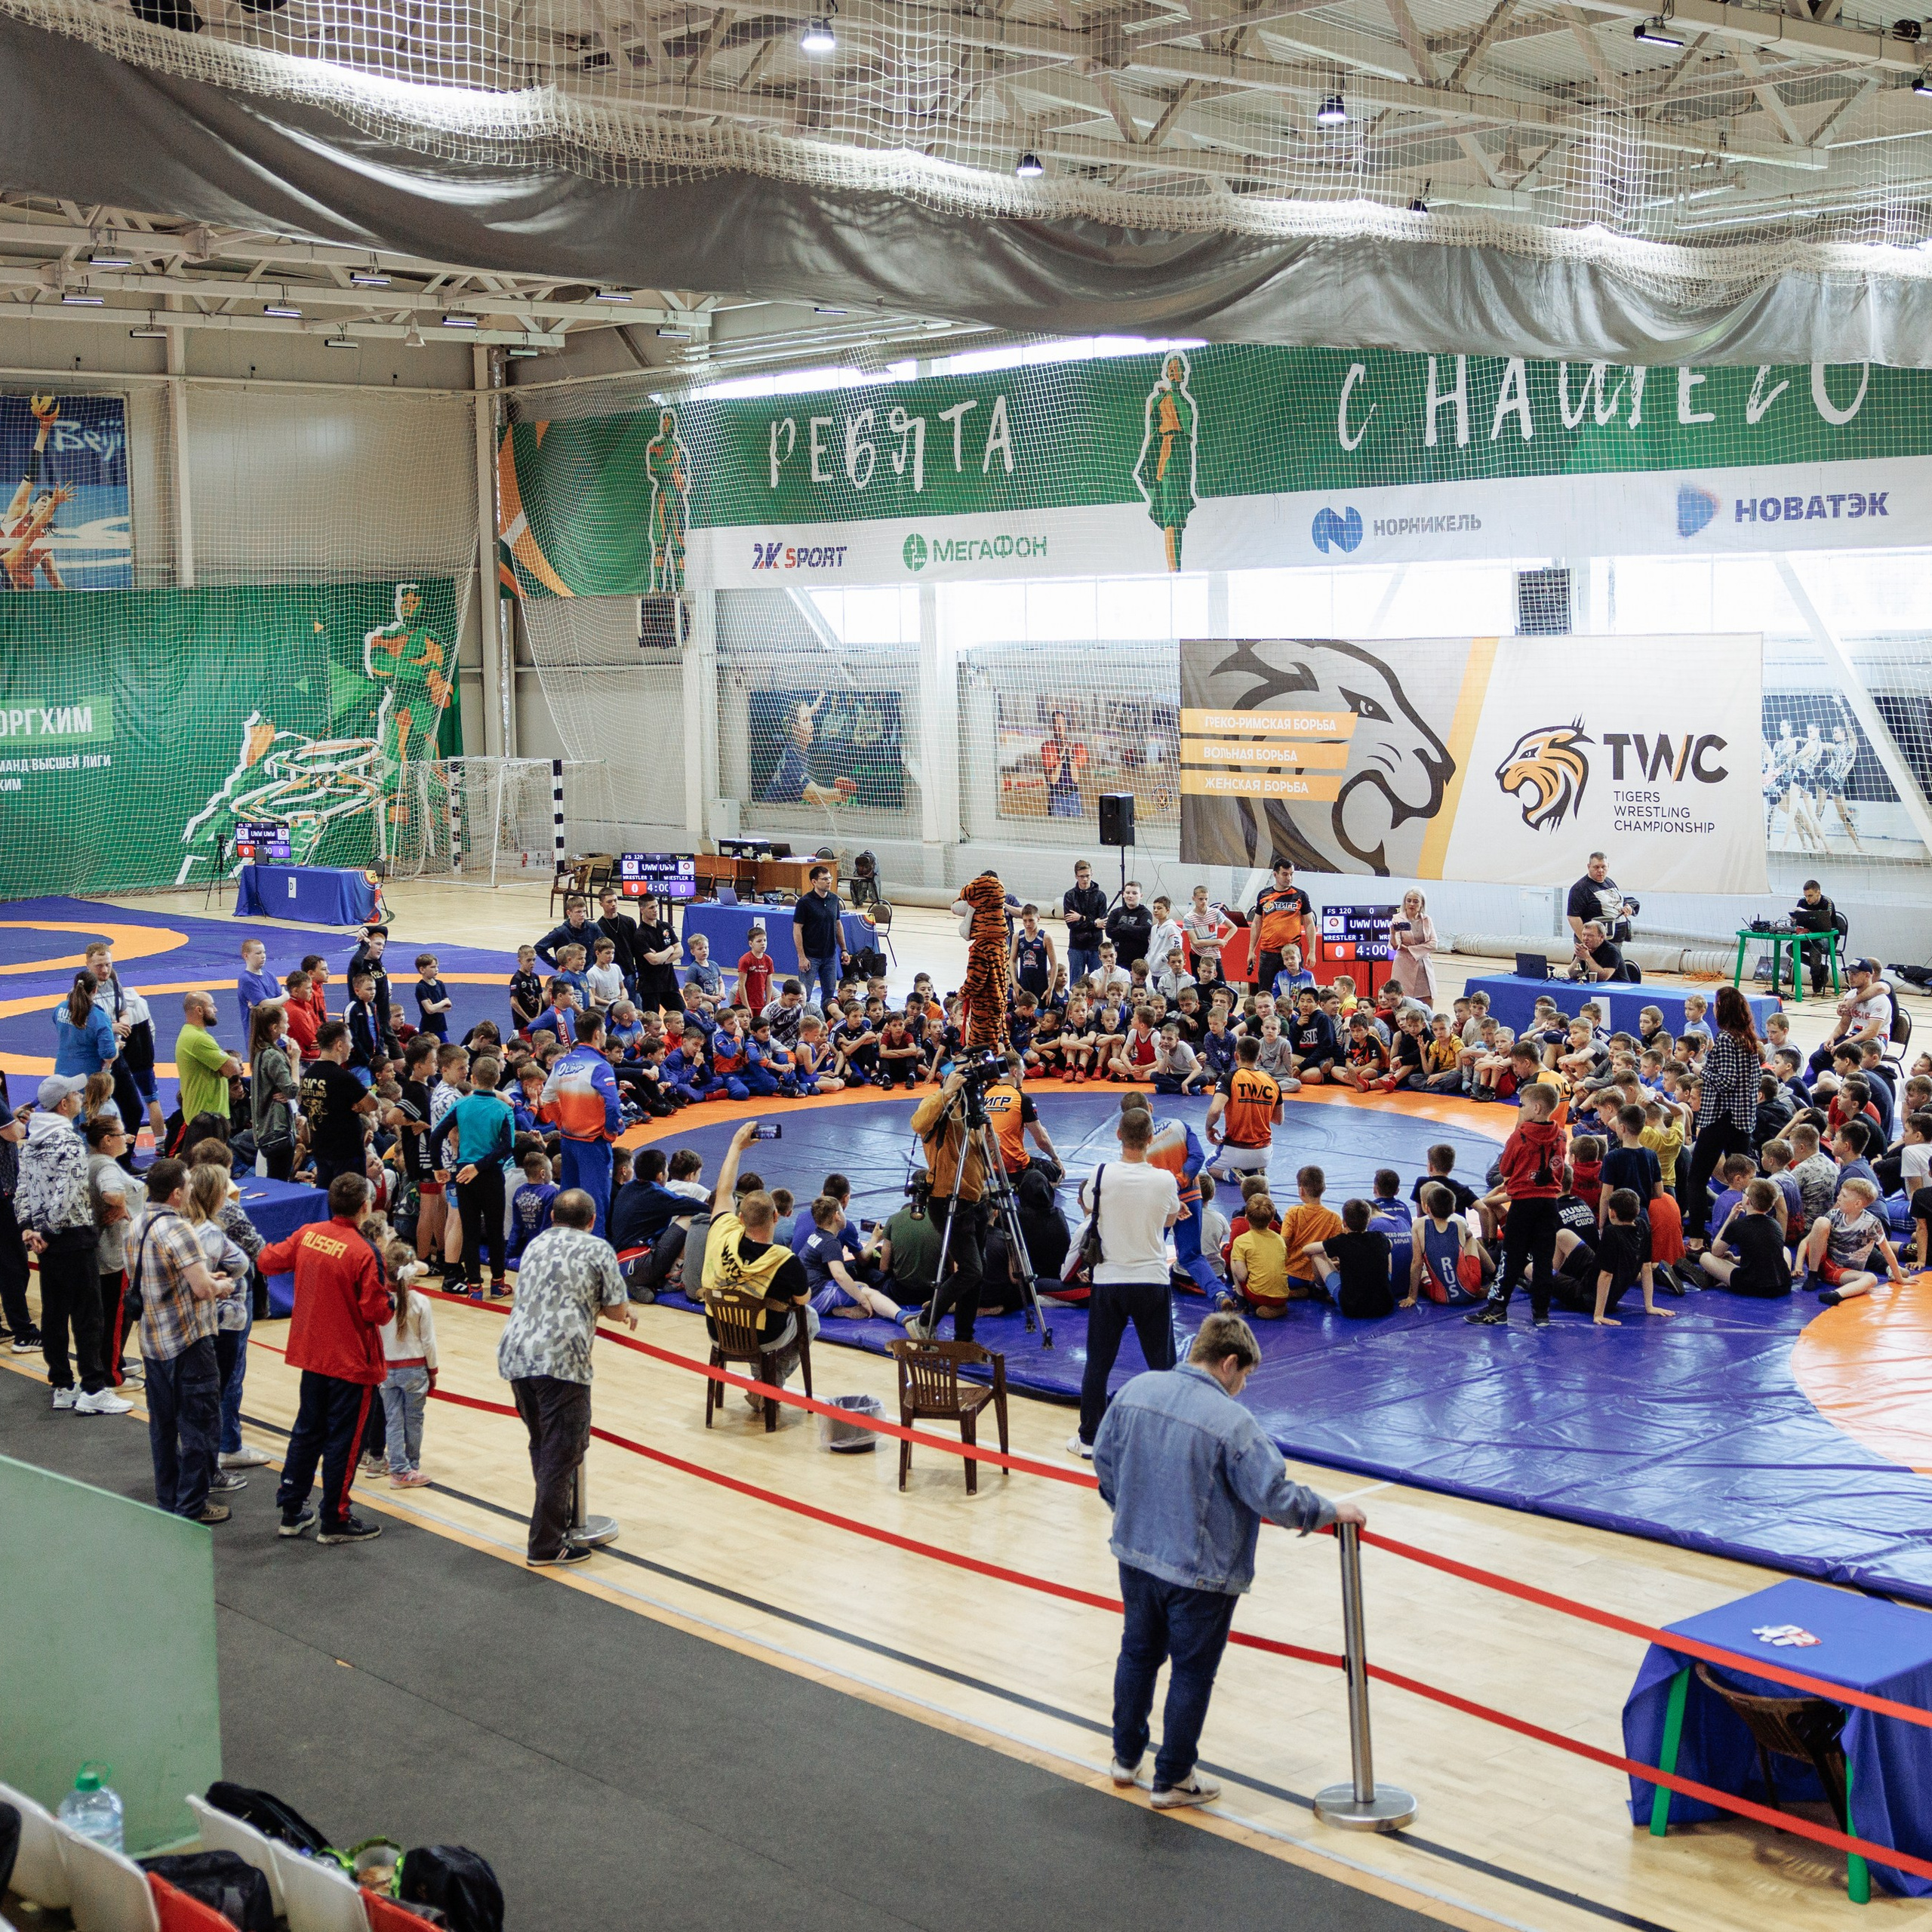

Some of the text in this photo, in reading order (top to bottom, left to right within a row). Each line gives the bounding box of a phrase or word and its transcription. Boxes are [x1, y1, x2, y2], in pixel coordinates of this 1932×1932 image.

[1734, 491, 1890, 523] НОВАТЭК
[1373, 514, 1482, 537] НОРНИКЕЛЬ
[1204, 716, 1337, 731] ГРЕКО-РИМСКАЯ БОРЬБА
[1204, 746, 1298, 761] ВОЛЬНАЯ БОРЬБА
[1603, 731, 1729, 784] TWC
[32, 754, 79, 771] ВЫСШЕЙ
[82, 755, 111, 768] ЛИГИ
[1204, 777, 1309, 793] ЖЕНСКАЯ БОРЬБА
[1614, 790, 1660, 803] TIGERS
[1614, 804, 1690, 818] WRESTLING
[1614, 820, 1715, 833] CHAMPIONSHIP
[243, 847, 249, 855] 0
[631, 883, 638, 894] 0
[647, 883, 669, 892] 4:00
[679, 884, 686, 894] 0
[1349, 919, 1371, 928] UWW
[1335, 945, 1345, 958] 0
[1356, 944, 1387, 955] 4:00
[301, 1231, 348, 1260] RUSSIA
